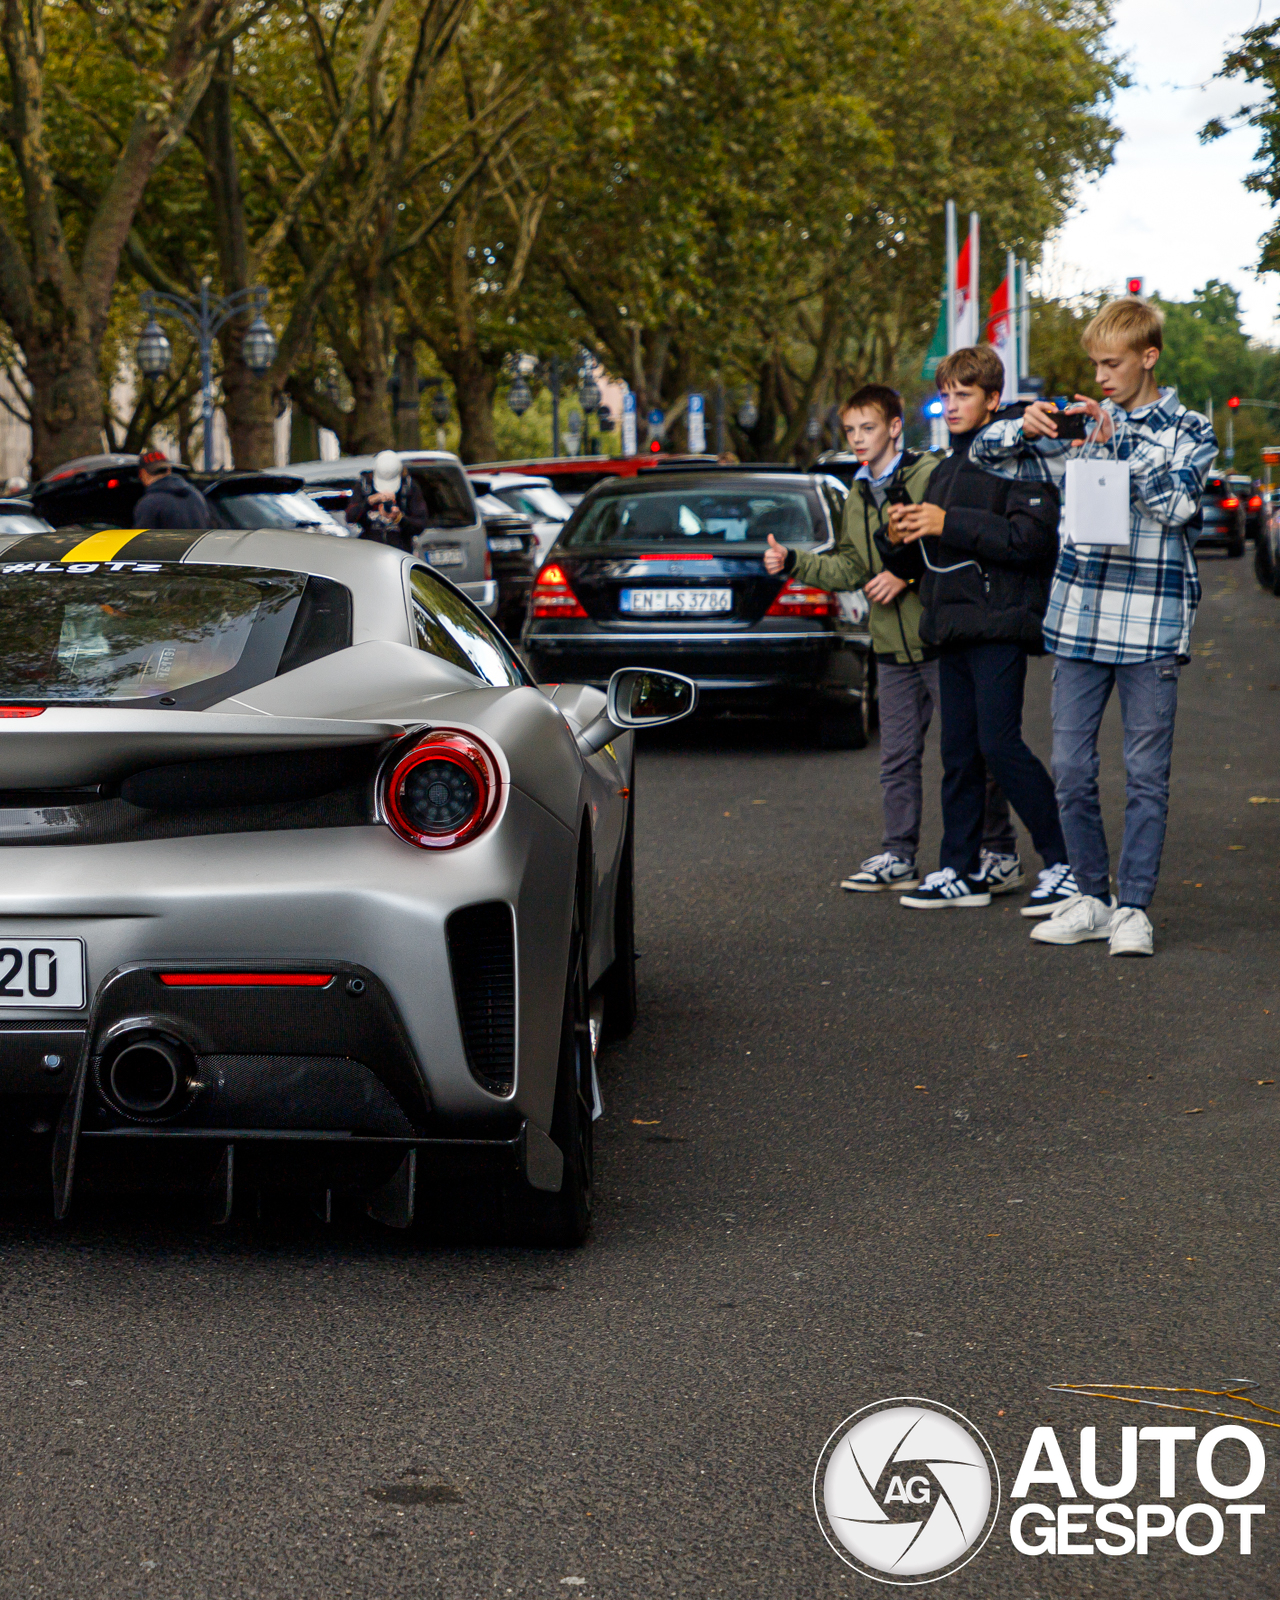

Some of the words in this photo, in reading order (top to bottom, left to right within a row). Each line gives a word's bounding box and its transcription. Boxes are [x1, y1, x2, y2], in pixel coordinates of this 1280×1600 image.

[2, 561, 163, 574] #LgTz
[633, 593, 653, 608] EN
[665, 593, 685, 608] LS
[689, 593, 728, 608] 3786
